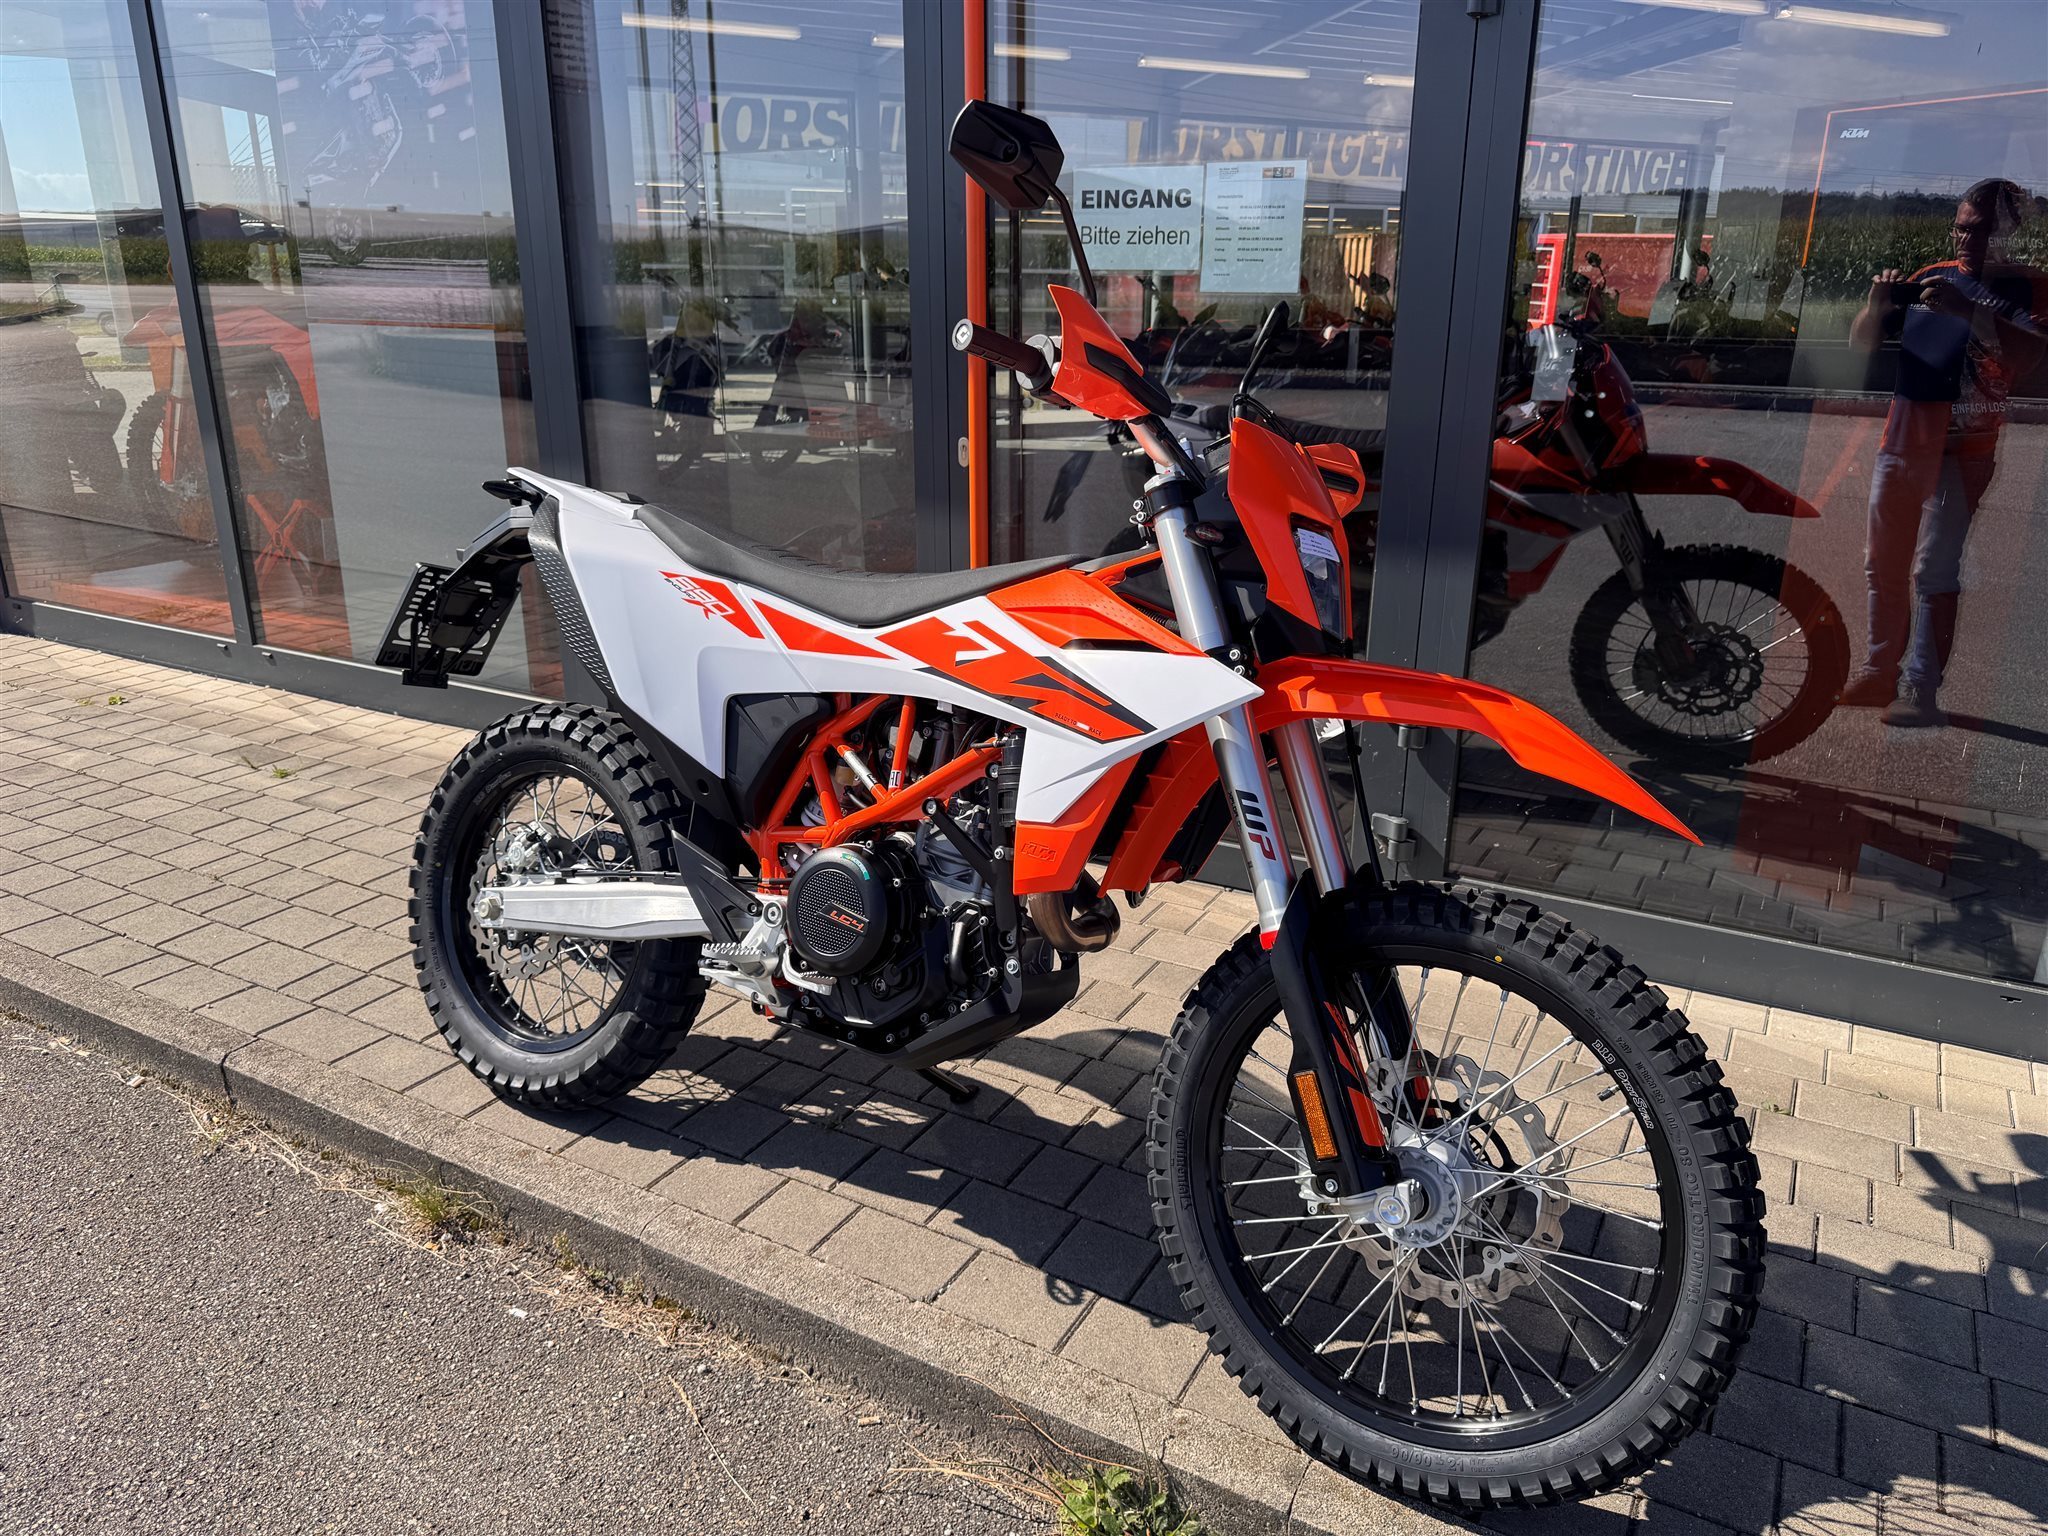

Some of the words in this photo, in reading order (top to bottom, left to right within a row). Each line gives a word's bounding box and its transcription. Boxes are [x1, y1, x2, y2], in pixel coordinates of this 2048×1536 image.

[1840, 128, 1870, 138] KTM
[1081, 188, 1192, 209] EINGANG
[1081, 226, 1120, 245] Bitte
[1126, 226, 1190, 245] ziehen
[1952, 402, 1987, 414] EINFACH
[1988, 402, 2006, 412] LOS
[1235, 790, 1277, 860] WP
[1021, 842, 1057, 862] KTM
[830, 910, 864, 930] LC4
[1592, 1039, 1616, 1064] DID
[1677, 1145, 1693, 1168] 80
[1684, 1171, 1702, 1213] TKC
[1391, 1445, 1432, 1467] 90/90
[1448, 1457, 1465, 1472] 21
